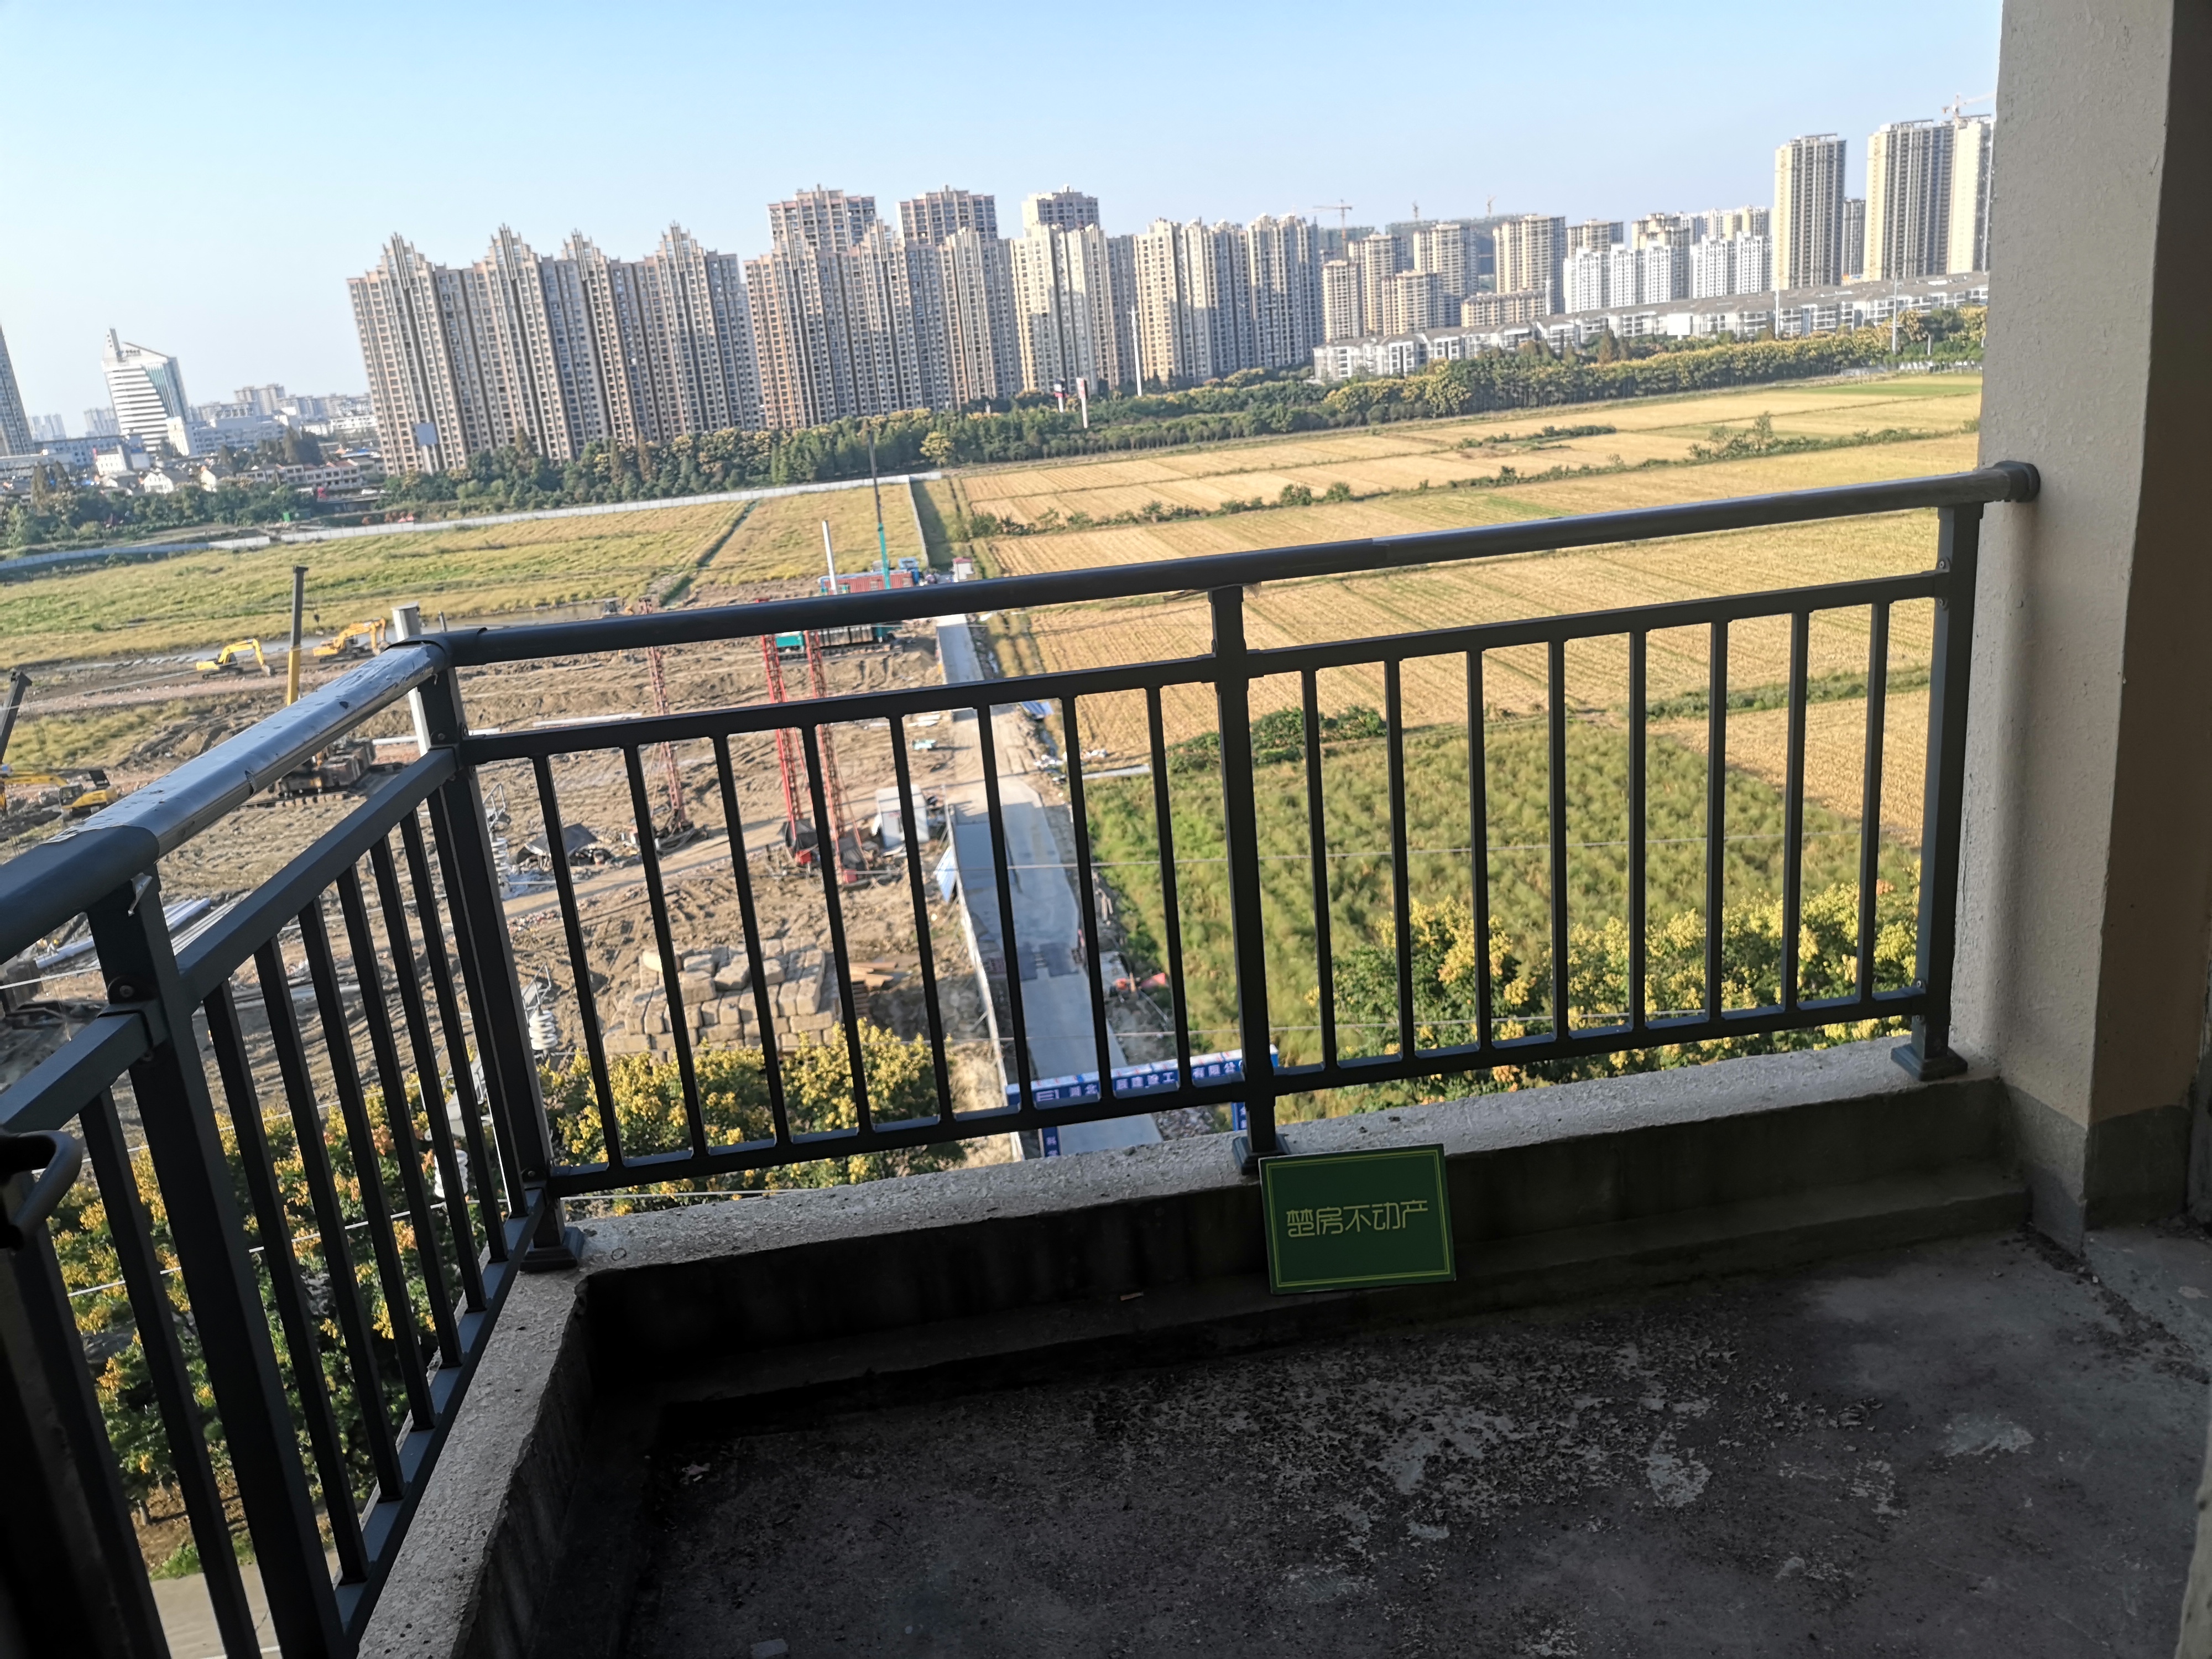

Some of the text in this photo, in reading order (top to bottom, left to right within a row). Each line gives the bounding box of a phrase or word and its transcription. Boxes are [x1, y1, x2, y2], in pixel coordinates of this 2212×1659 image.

[1286, 1199, 1428, 1238] 楚房不动产
